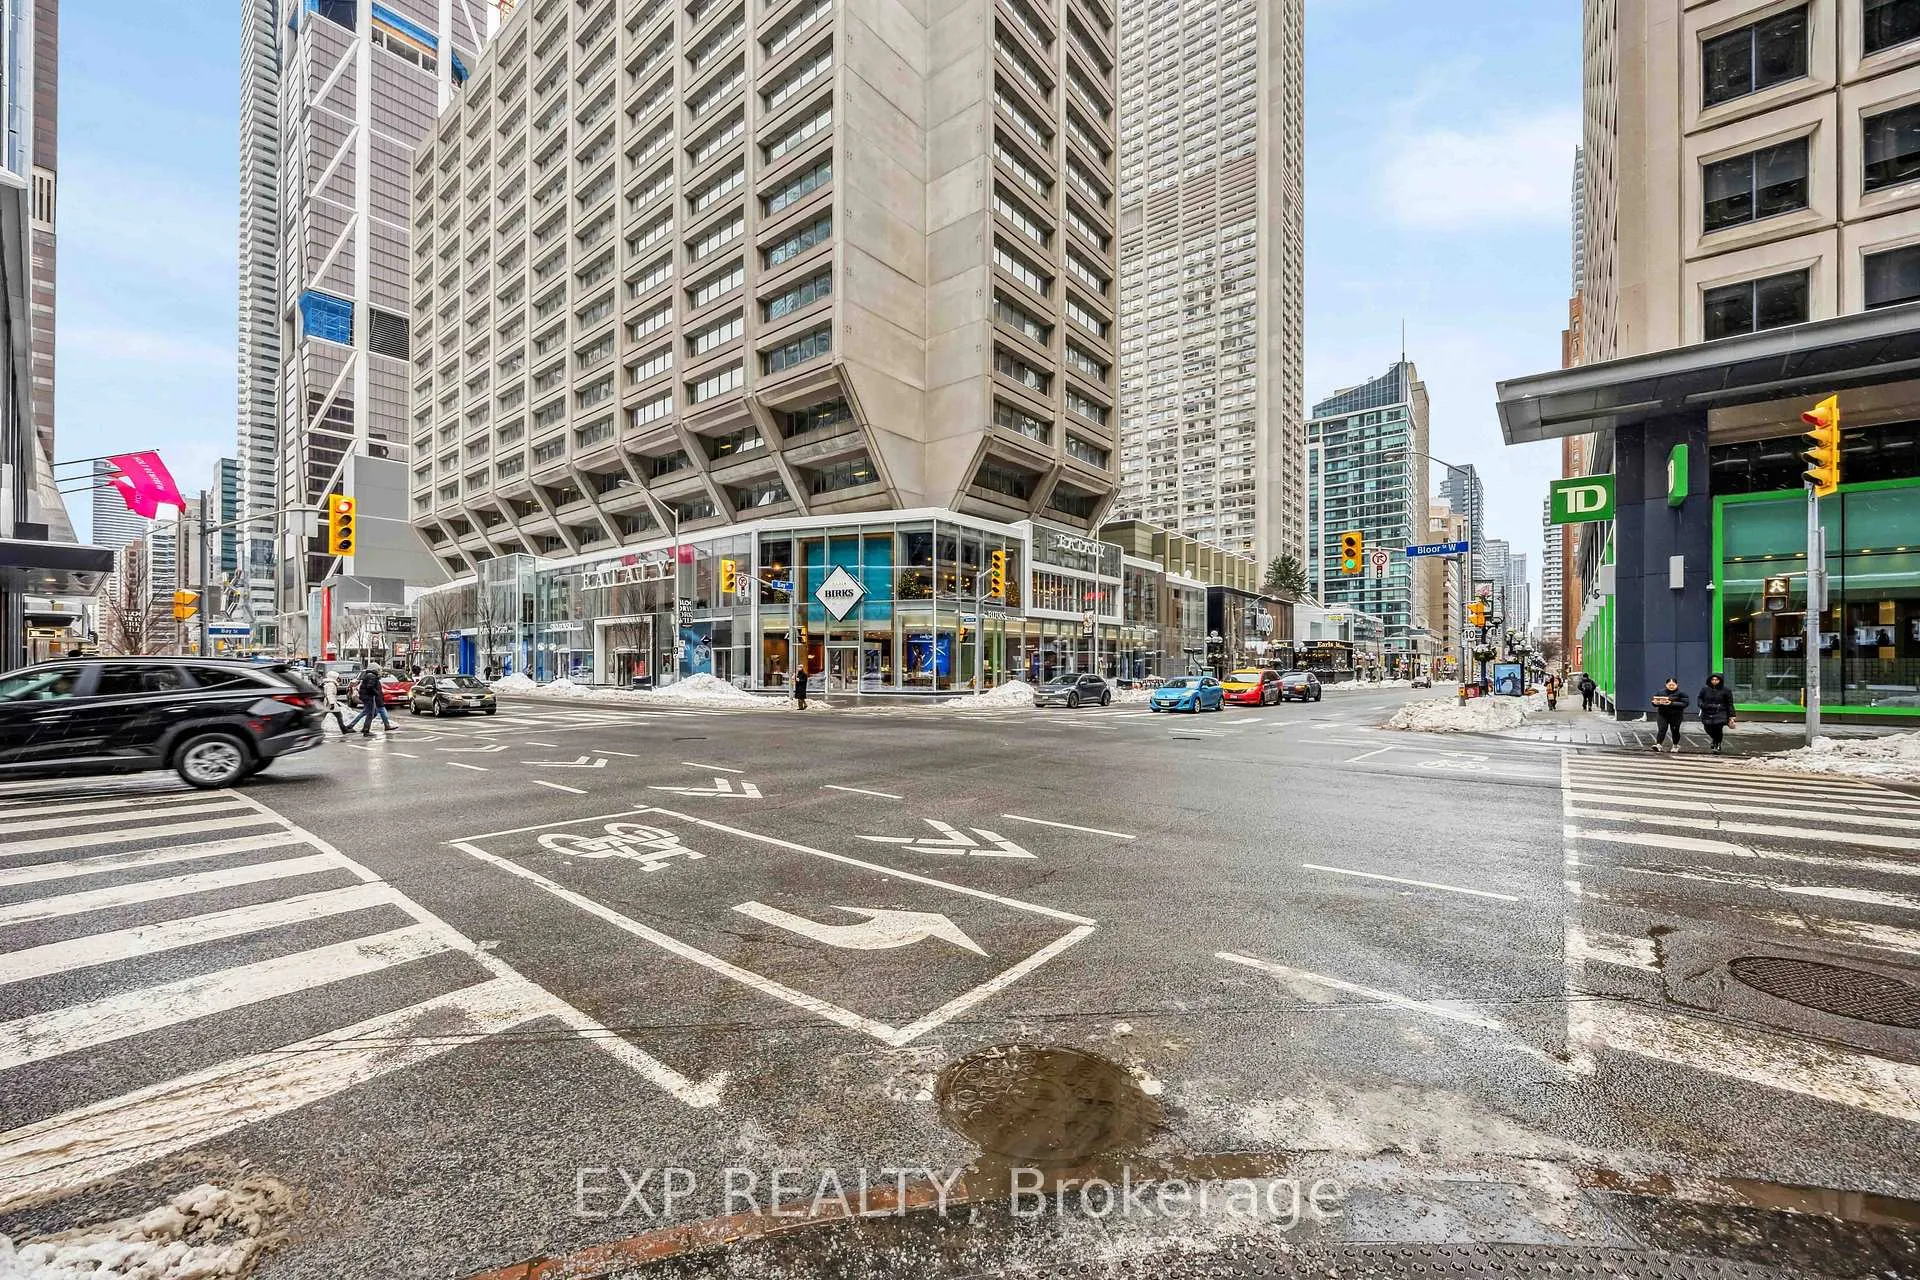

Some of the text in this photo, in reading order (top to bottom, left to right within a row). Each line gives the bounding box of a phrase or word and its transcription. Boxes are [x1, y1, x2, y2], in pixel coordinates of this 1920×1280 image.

[1557, 485, 1607, 513] TD
[1417, 546, 1441, 554] Bloor
[1448, 543, 1457, 551] W
[583, 559, 669, 590] EATALY
[825, 589, 854, 598] BIRKS
